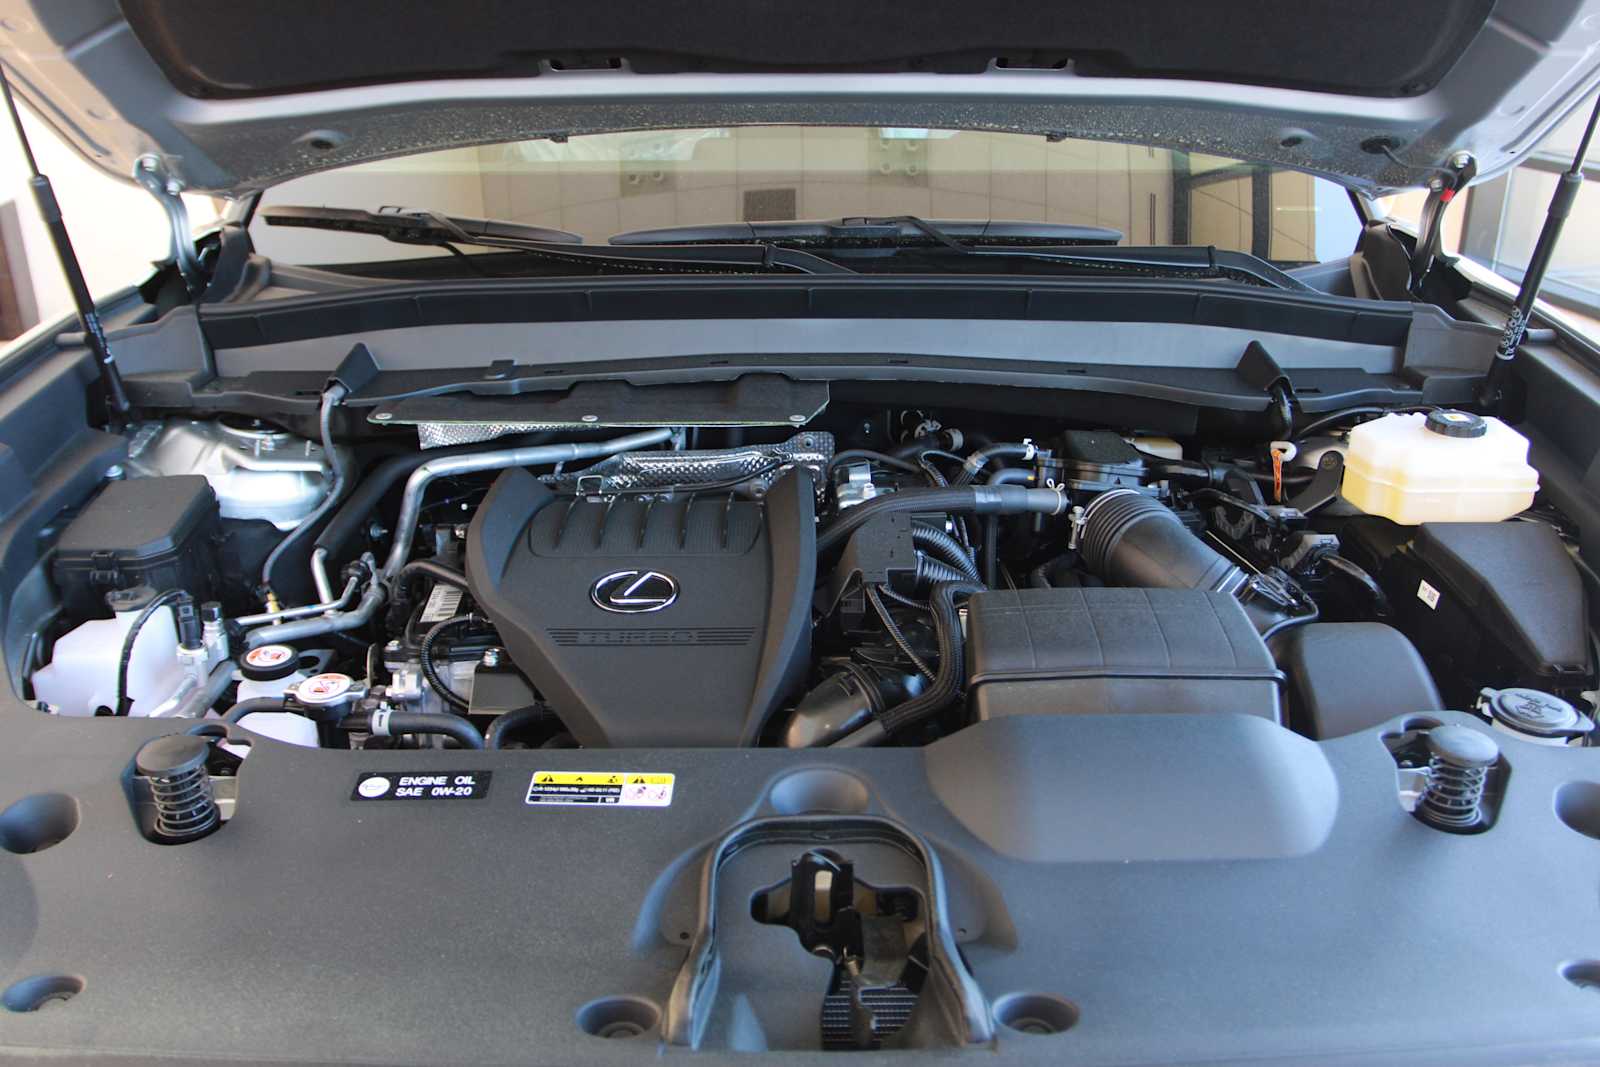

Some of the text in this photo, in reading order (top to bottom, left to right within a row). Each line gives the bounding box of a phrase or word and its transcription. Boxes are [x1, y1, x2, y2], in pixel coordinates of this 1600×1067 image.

[583, 631, 692, 642] TURBO
[399, 775, 476, 786] ENGINE OIL
[395, 787, 473, 797] SAE 0W-20
